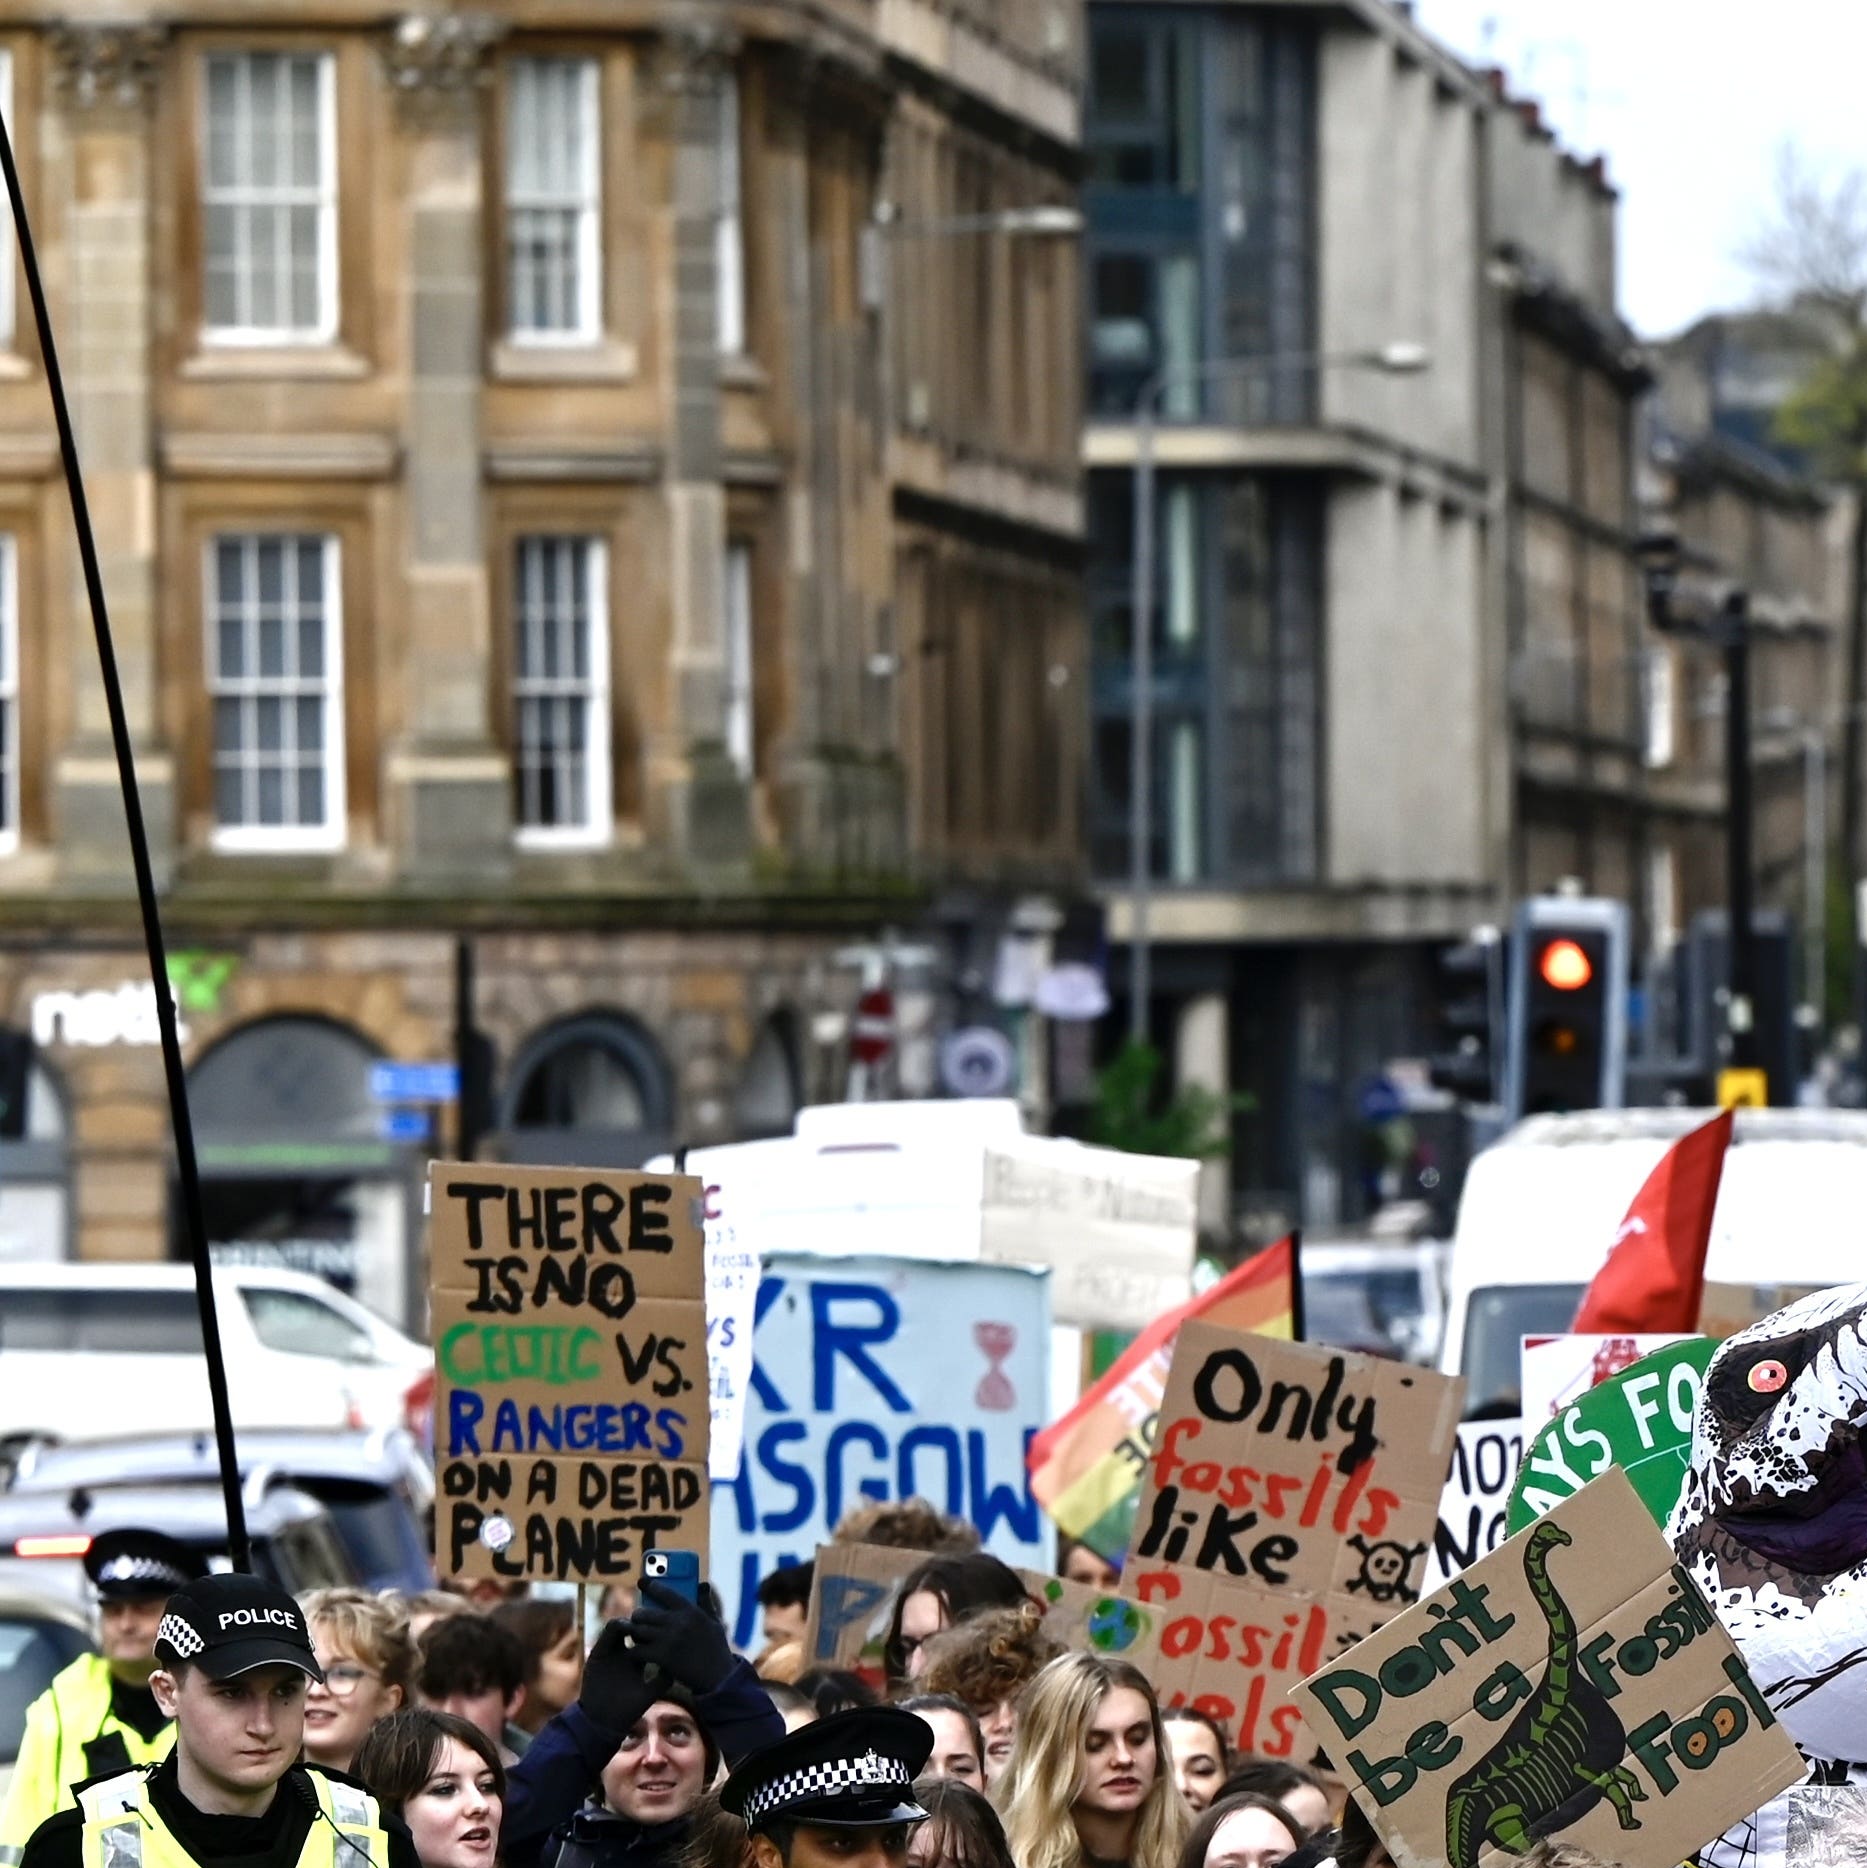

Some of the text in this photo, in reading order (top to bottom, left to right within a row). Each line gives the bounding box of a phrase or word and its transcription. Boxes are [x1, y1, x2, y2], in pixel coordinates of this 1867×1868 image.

[447, 1182, 674, 1256] THERE
[464, 1257, 528, 1315] IS
[531, 1254, 636, 1319] NO
[440, 1321, 602, 1386] CELTIC
[615, 1332, 693, 1397] VS.
[449, 1389, 687, 1459] RANGERS
[1193, 1349, 1377, 1476] Only
[1621, 1361, 1702, 1450] FO
[442, 1459, 702, 1511] ON A DEAD
[1149, 1417, 1400, 1537] fossils
[450, 1502, 682, 1577] PLANET
[1138, 1485, 1299, 1585] like
[218, 1607, 299, 1631] POLICE
[1308, 1576, 1516, 1743] Don't
[1578, 1564, 1716, 1701] Fossil
[1345, 1660, 1533, 1808] be a
[1625, 1652, 1775, 1797] Fool
